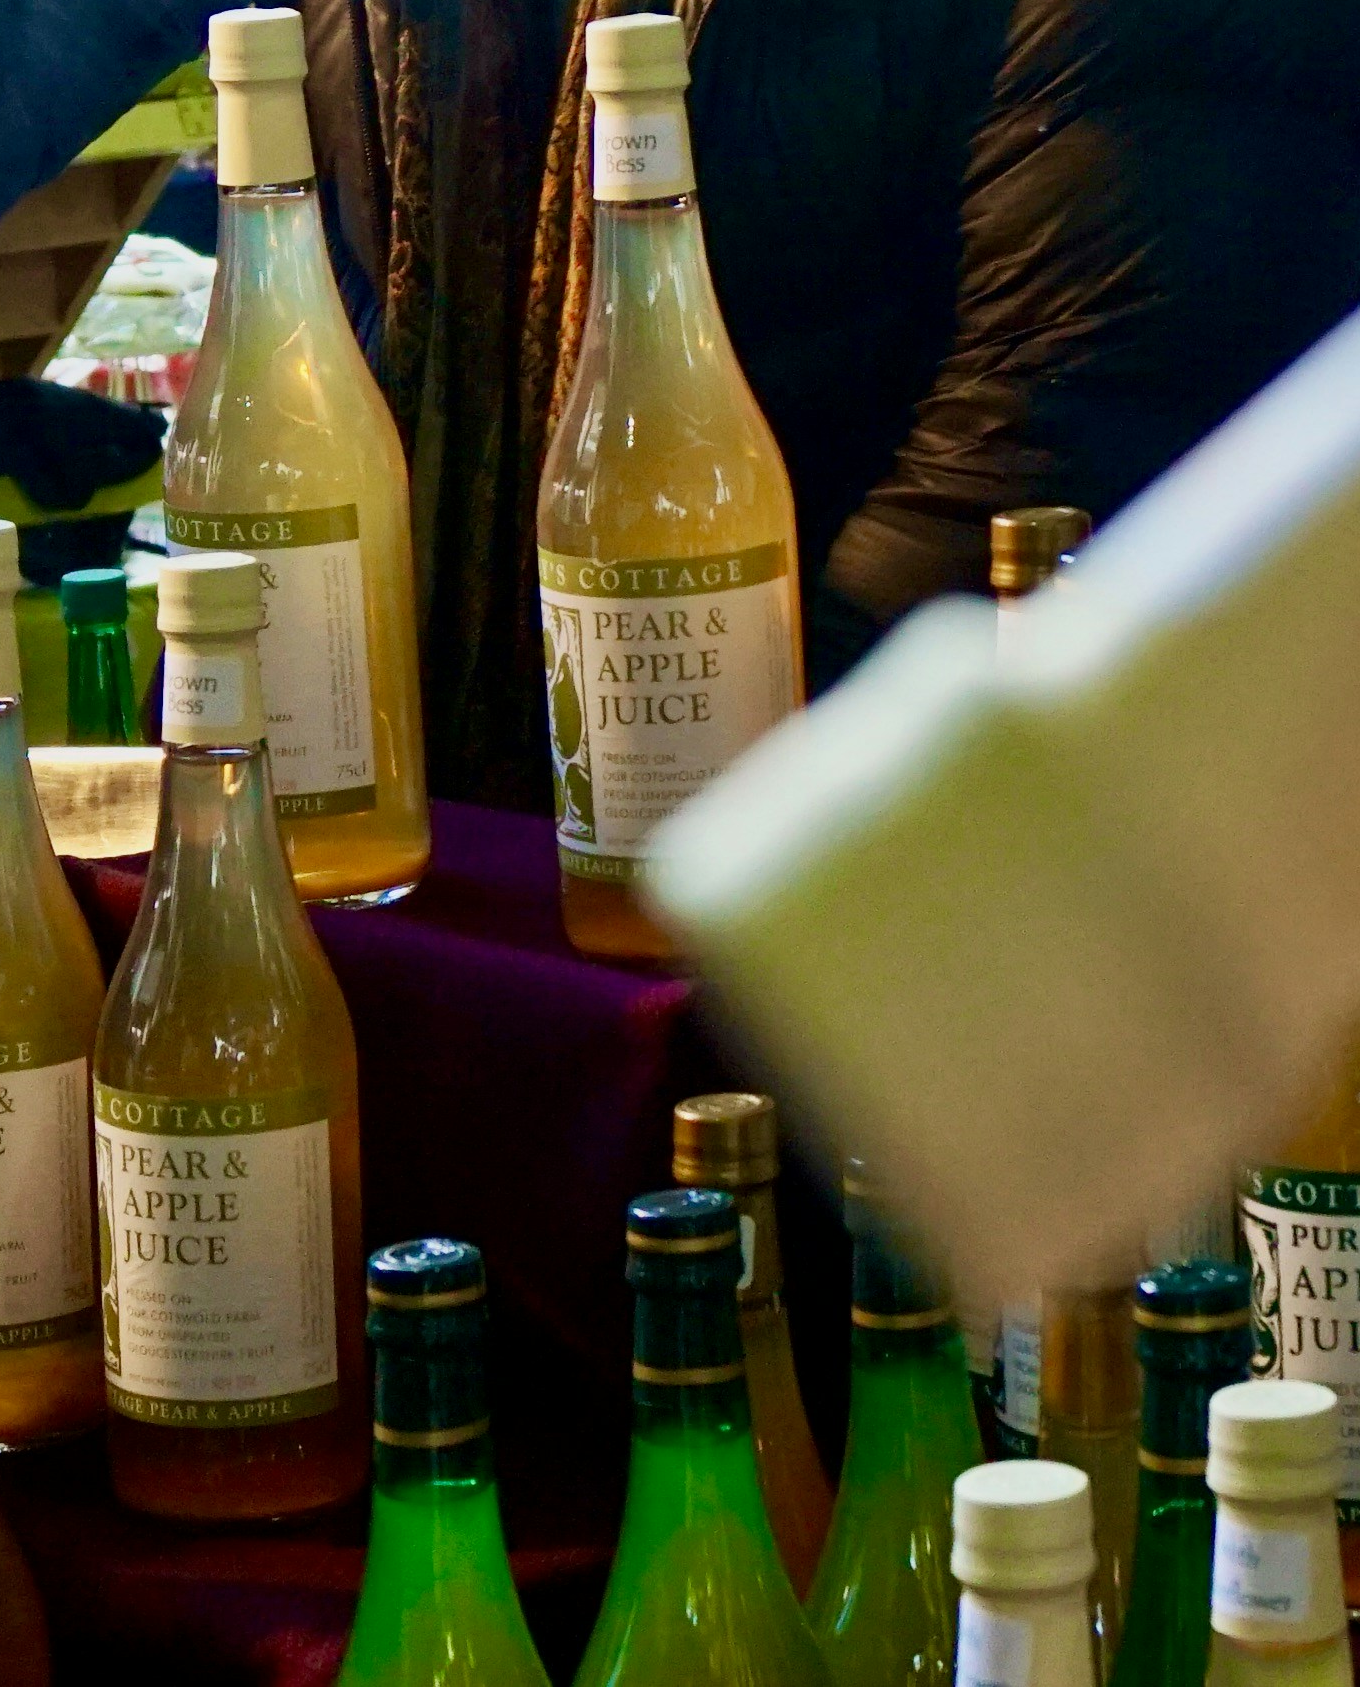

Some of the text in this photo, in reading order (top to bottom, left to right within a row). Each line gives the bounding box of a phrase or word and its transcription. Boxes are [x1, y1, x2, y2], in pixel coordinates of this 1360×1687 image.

[578, 559, 742, 591] COTTAGE
[593, 607, 728, 641] PEAR &
[598, 649, 722, 683] APPLE
[598, 693, 712, 730] JUICE
[279, 797, 326, 814] PPLE
[110, 1098, 266, 1130] COTTAGE
[121, 1144, 249, 1180] PEAR &
[124, 1188, 239, 1223] APPLE
[124, 1228, 228, 1266] JUICE
[149, 1401, 198, 1420] PEAR
